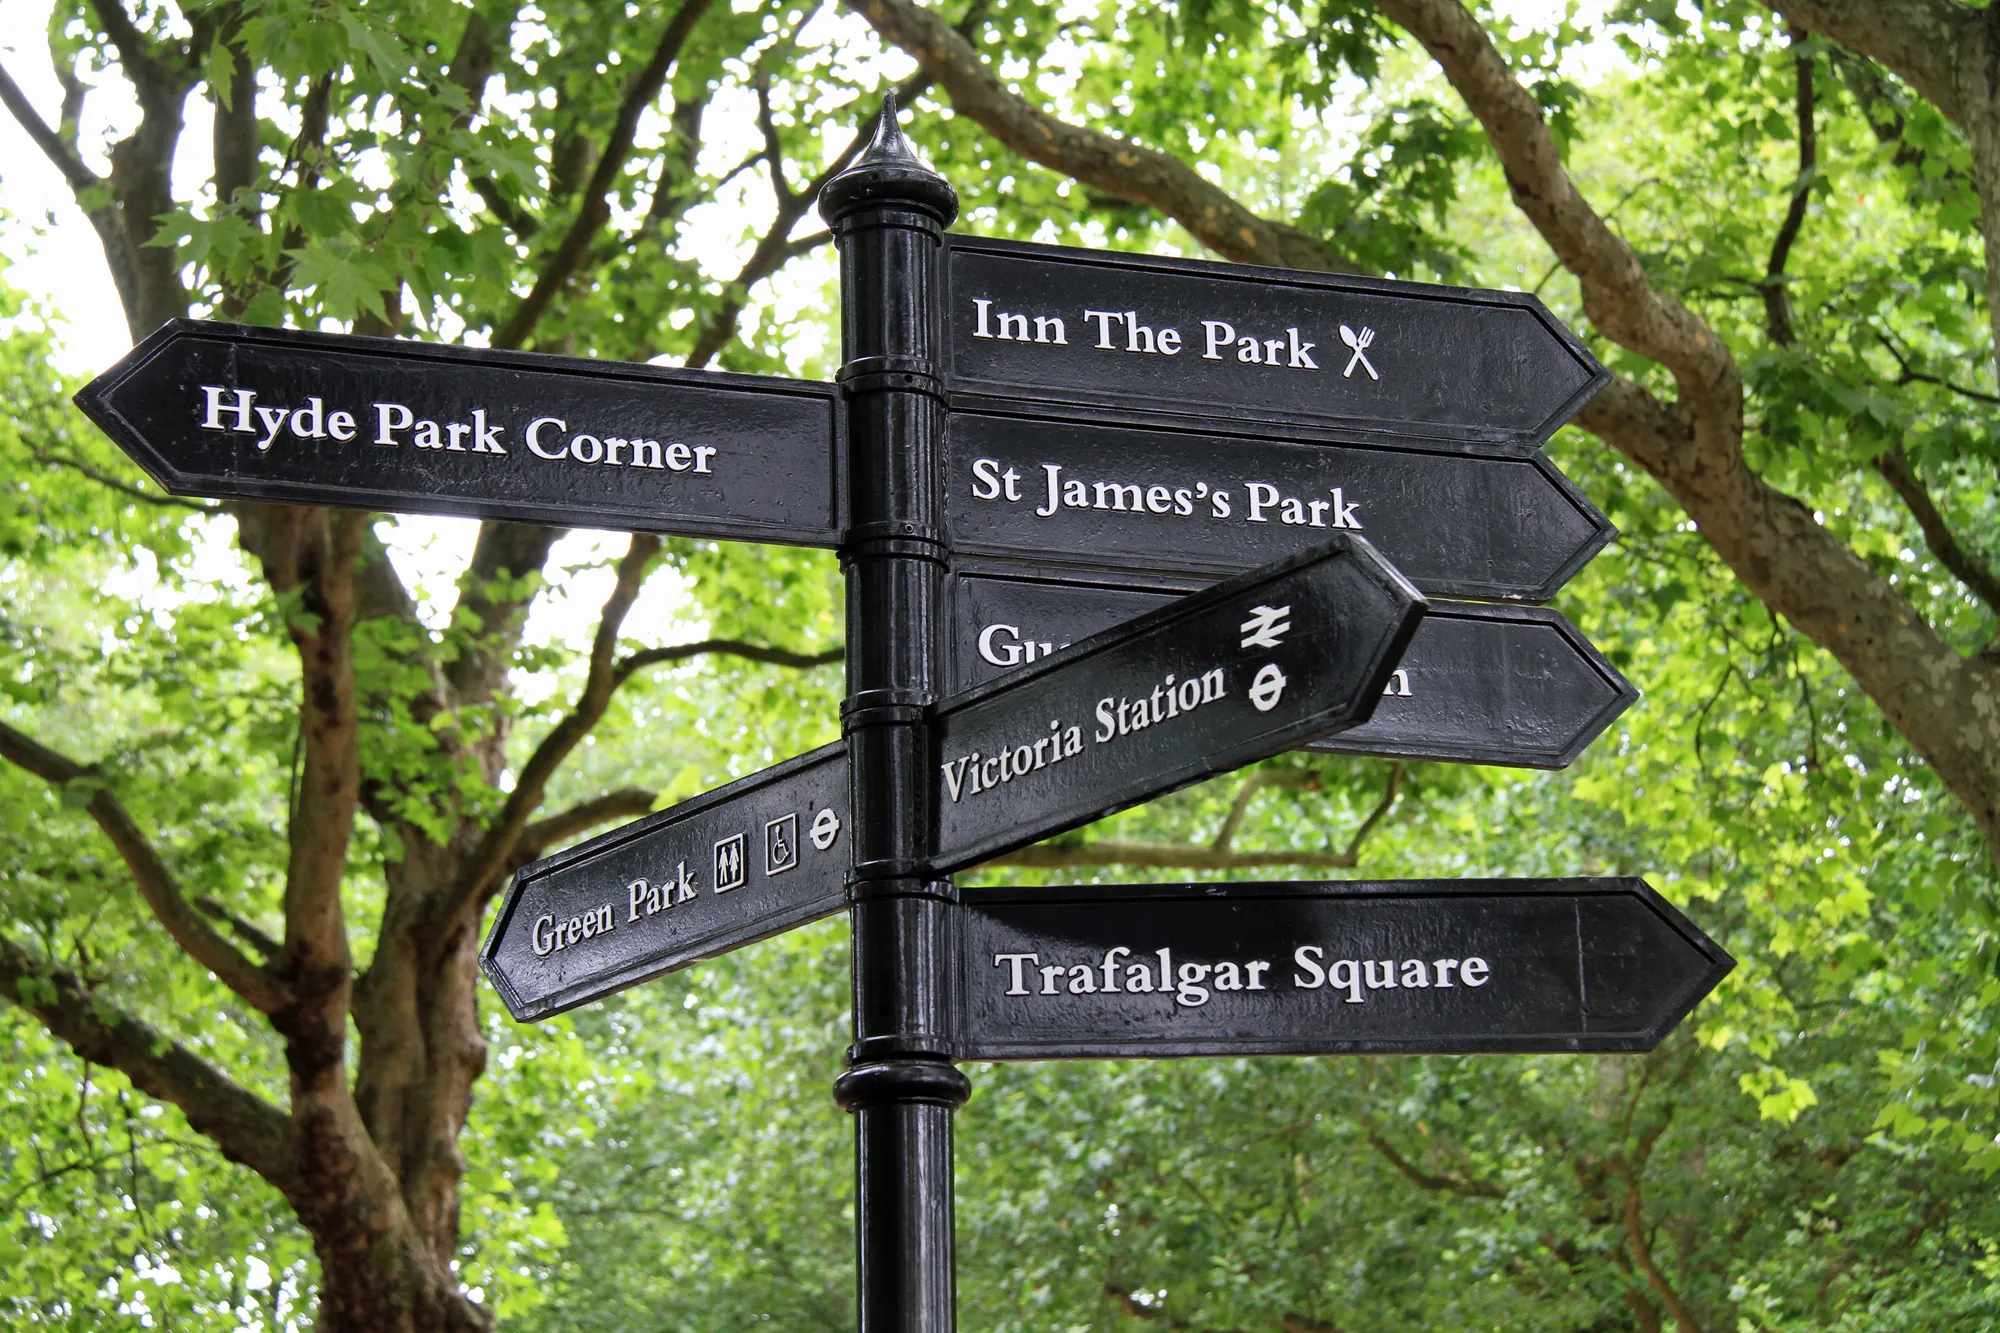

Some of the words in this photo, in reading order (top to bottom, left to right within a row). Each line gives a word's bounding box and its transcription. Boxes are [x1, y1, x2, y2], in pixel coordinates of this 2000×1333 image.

[973, 299, 1069, 345] Inn
[1085, 309, 1182, 355] The
[1201, 320, 1319, 369] Park
[201, 385, 356, 450] Hyde
[374, 404, 507, 454] Park
[525, 417, 717, 473] Corner
[972, 458, 1022, 502] St
[1037, 464, 1231, 518] James’s
[1245, 482, 1364, 529] Park
[941, 719, 1084, 803] Victoria
[1095, 667, 1226, 743] Station
[532, 903, 614, 957] Green
[627, 861, 698, 923] Park
[994, 946, 1271, 1007] Trafalgar
[1294, 945, 1490, 1003] Square
